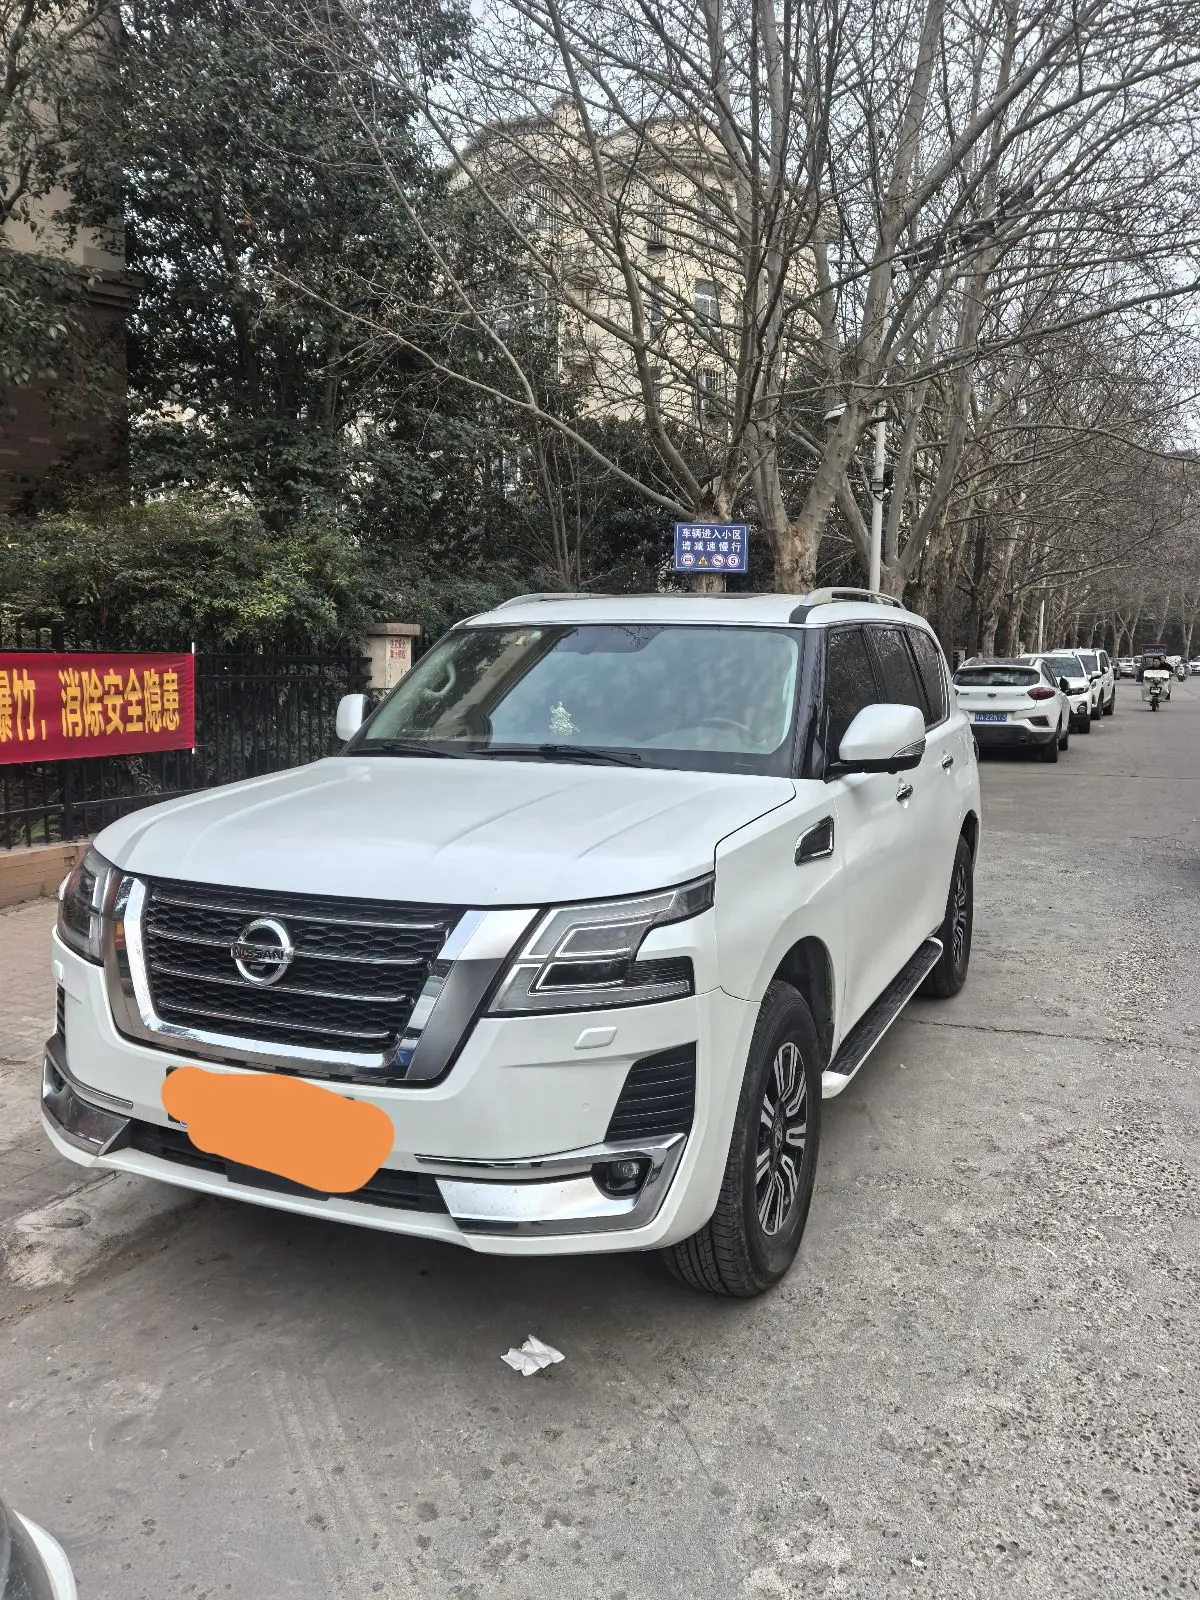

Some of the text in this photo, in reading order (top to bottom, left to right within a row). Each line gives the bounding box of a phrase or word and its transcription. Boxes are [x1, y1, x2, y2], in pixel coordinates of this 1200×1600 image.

[681, 528, 742, 540] 车辆进入小区
[681, 540, 742, 552] 请减速慢行
[234, 944, 284, 960] NISSAN
